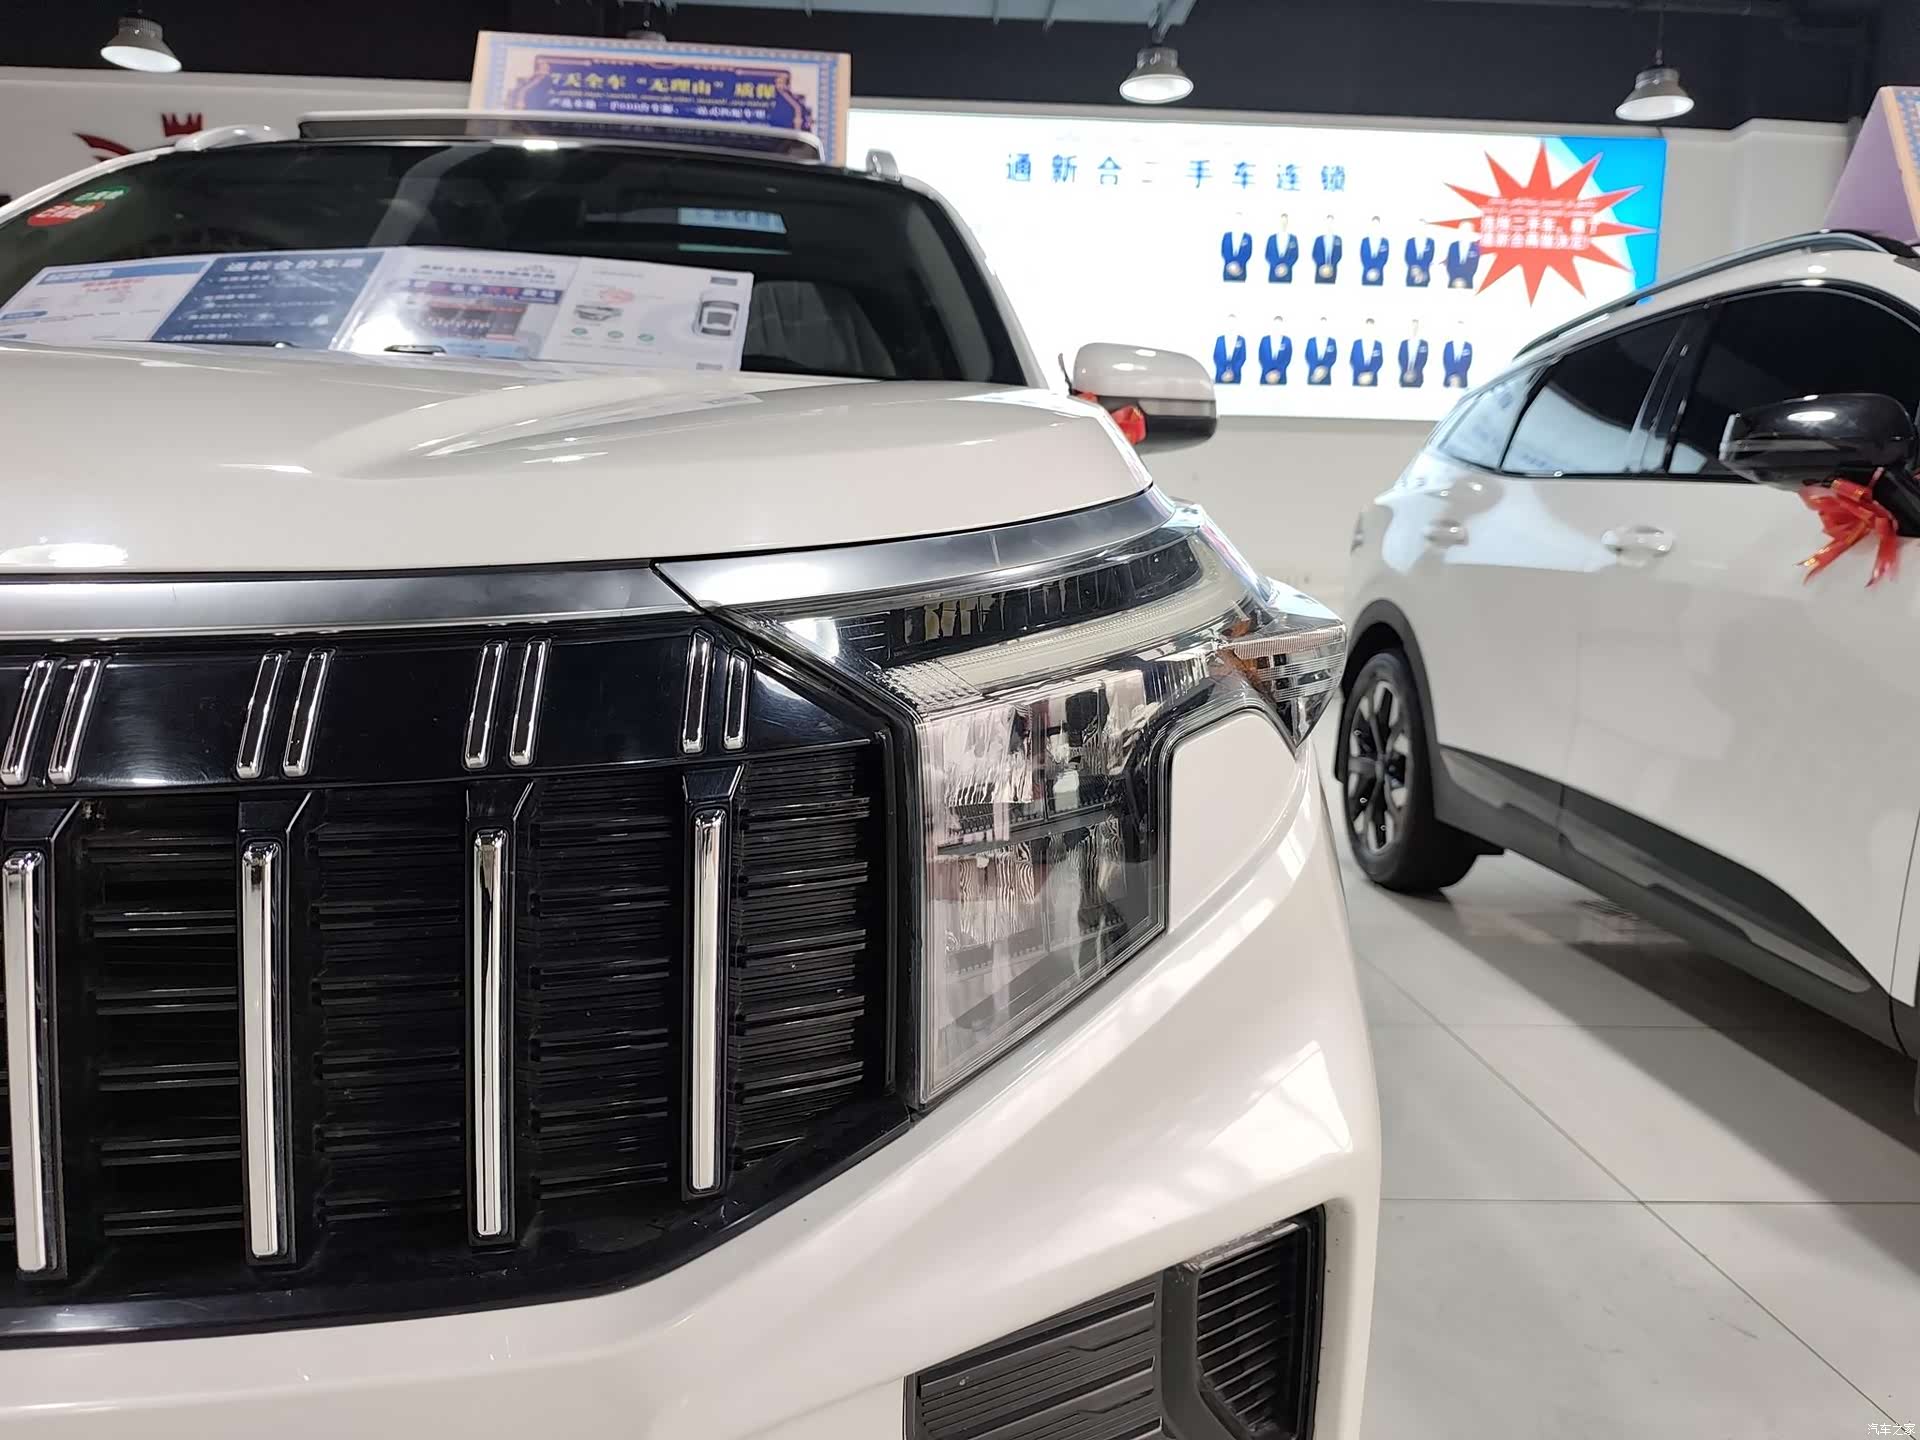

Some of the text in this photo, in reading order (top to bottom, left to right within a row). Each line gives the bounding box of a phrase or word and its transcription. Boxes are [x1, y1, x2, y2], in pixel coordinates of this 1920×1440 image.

[1005, 153, 1346, 192] 通新合二手车连锁
